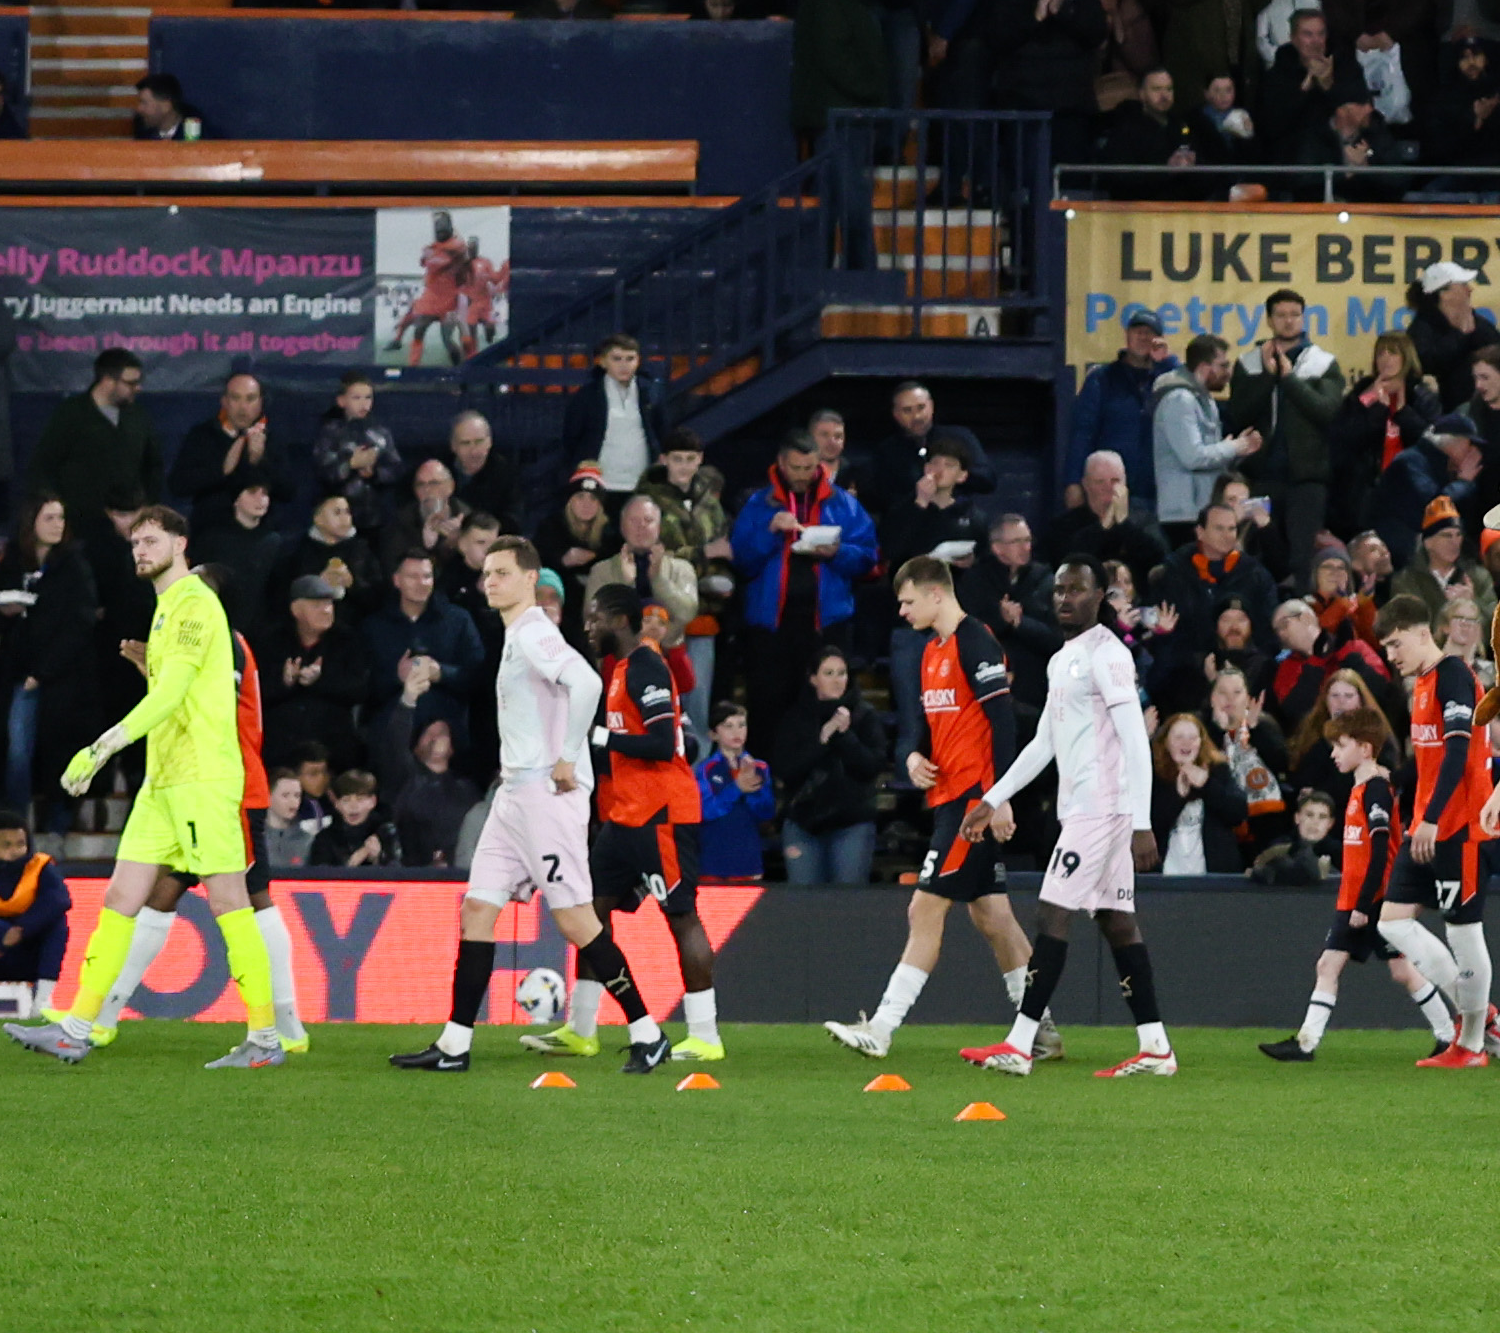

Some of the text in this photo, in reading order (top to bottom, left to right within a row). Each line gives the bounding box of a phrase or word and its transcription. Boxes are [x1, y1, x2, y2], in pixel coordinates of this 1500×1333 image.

[58, 247, 216, 279] Ruddock
[220, 248, 362, 285] Mpanzu
[1121, 231, 1292, 283] LUKE
[30, 294, 166, 320] Juggernaut
[169, 295, 243, 315] Needs
[248, 299, 277, 315] an
[283, 294, 362, 321] Engine
[37, 330, 99, 354] been
[202, 330, 224, 352] it
[228, 330, 255, 352] all
[258, 332, 362, 358] together
[187, 820, 198, 848] 1
[542, 854, 562, 883] 2
[1050, 847, 1081, 879] 19
